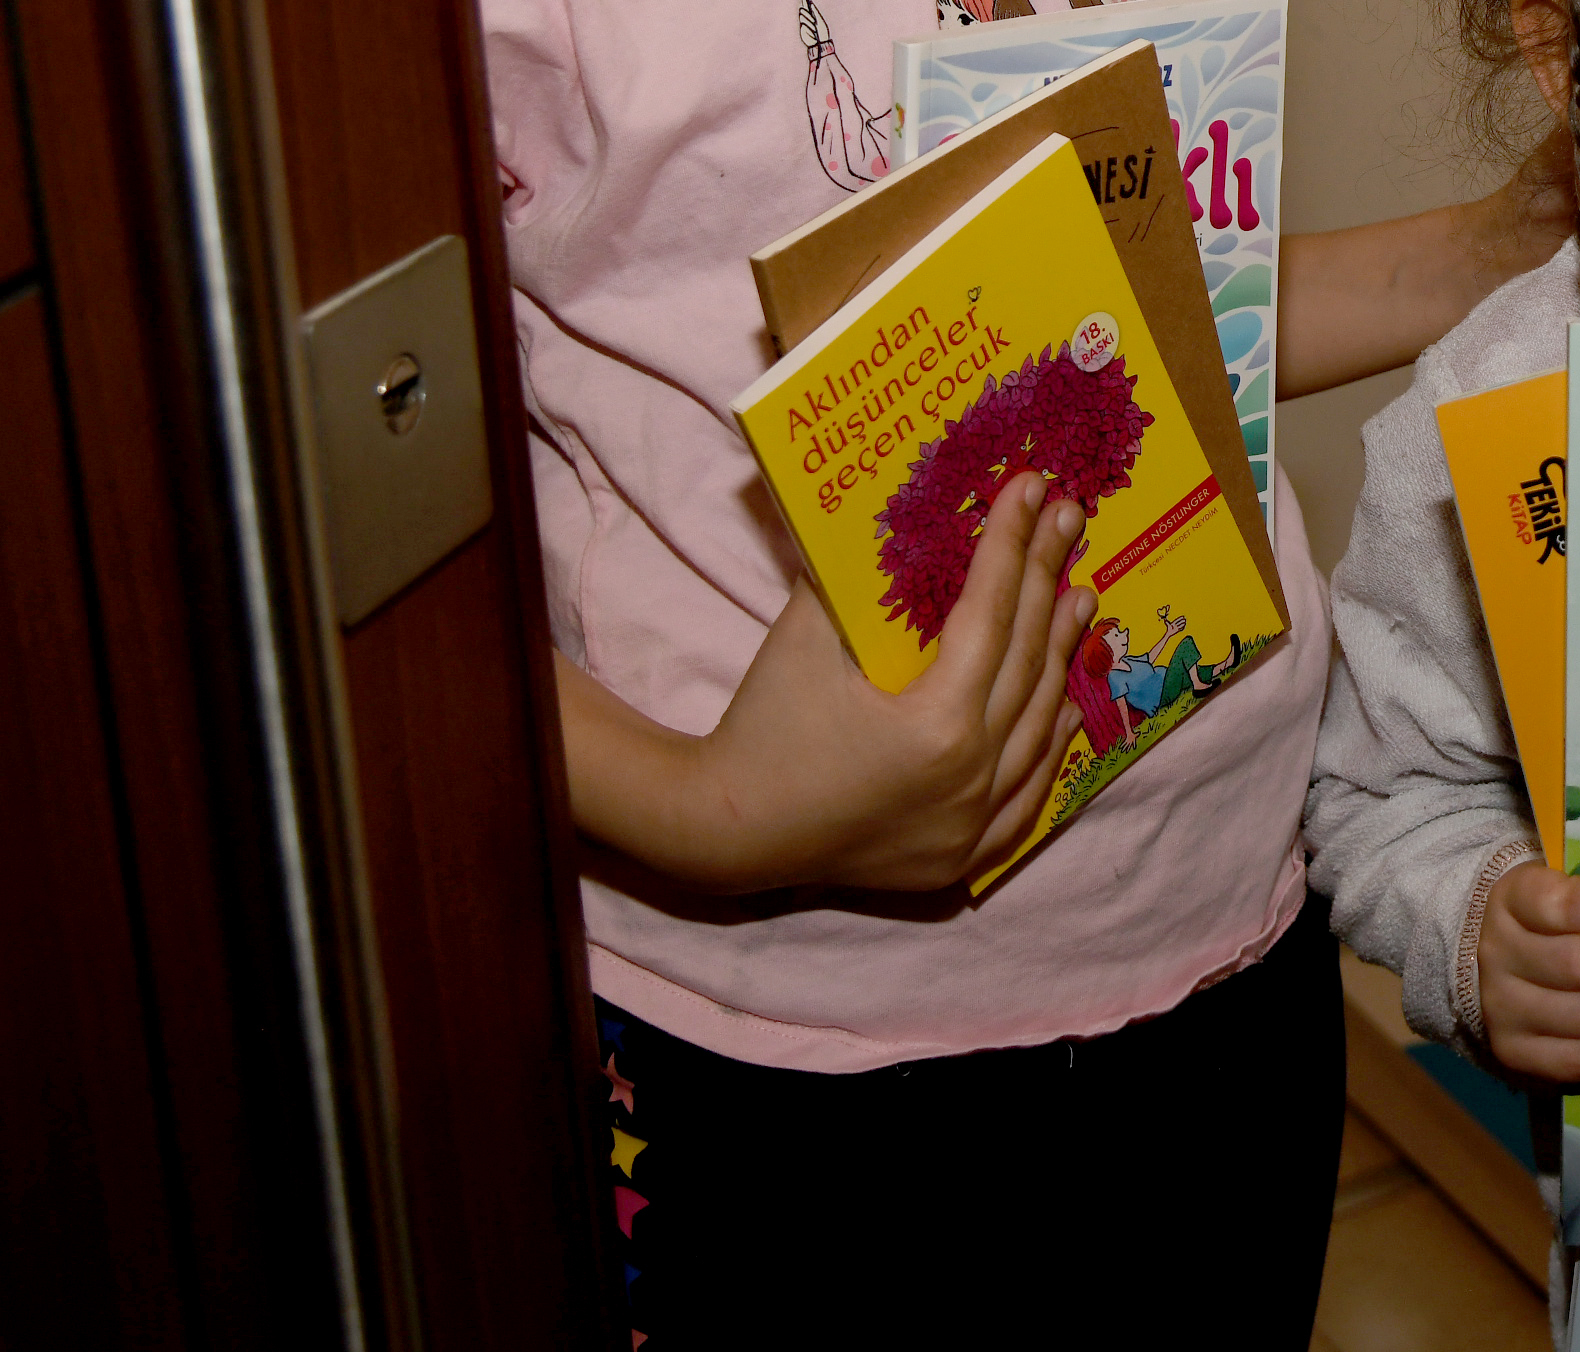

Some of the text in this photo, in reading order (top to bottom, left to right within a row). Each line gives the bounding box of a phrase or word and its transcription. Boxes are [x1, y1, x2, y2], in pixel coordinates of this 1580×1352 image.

[786, 305, 932, 442] Aklından
[1080, 321, 1106, 345] 18.
[1081, 332, 1115, 365] BASKI
[802, 304, 981, 474] düşünceler
[817, 324, 1011, 514] geçen çocuk
[1101, 488, 1210, 582] CHRISTINE NÖSTLINGER
[1139, 552, 1164, 576] Türkçesi
[1165, 530, 1191, 555] NECDET
